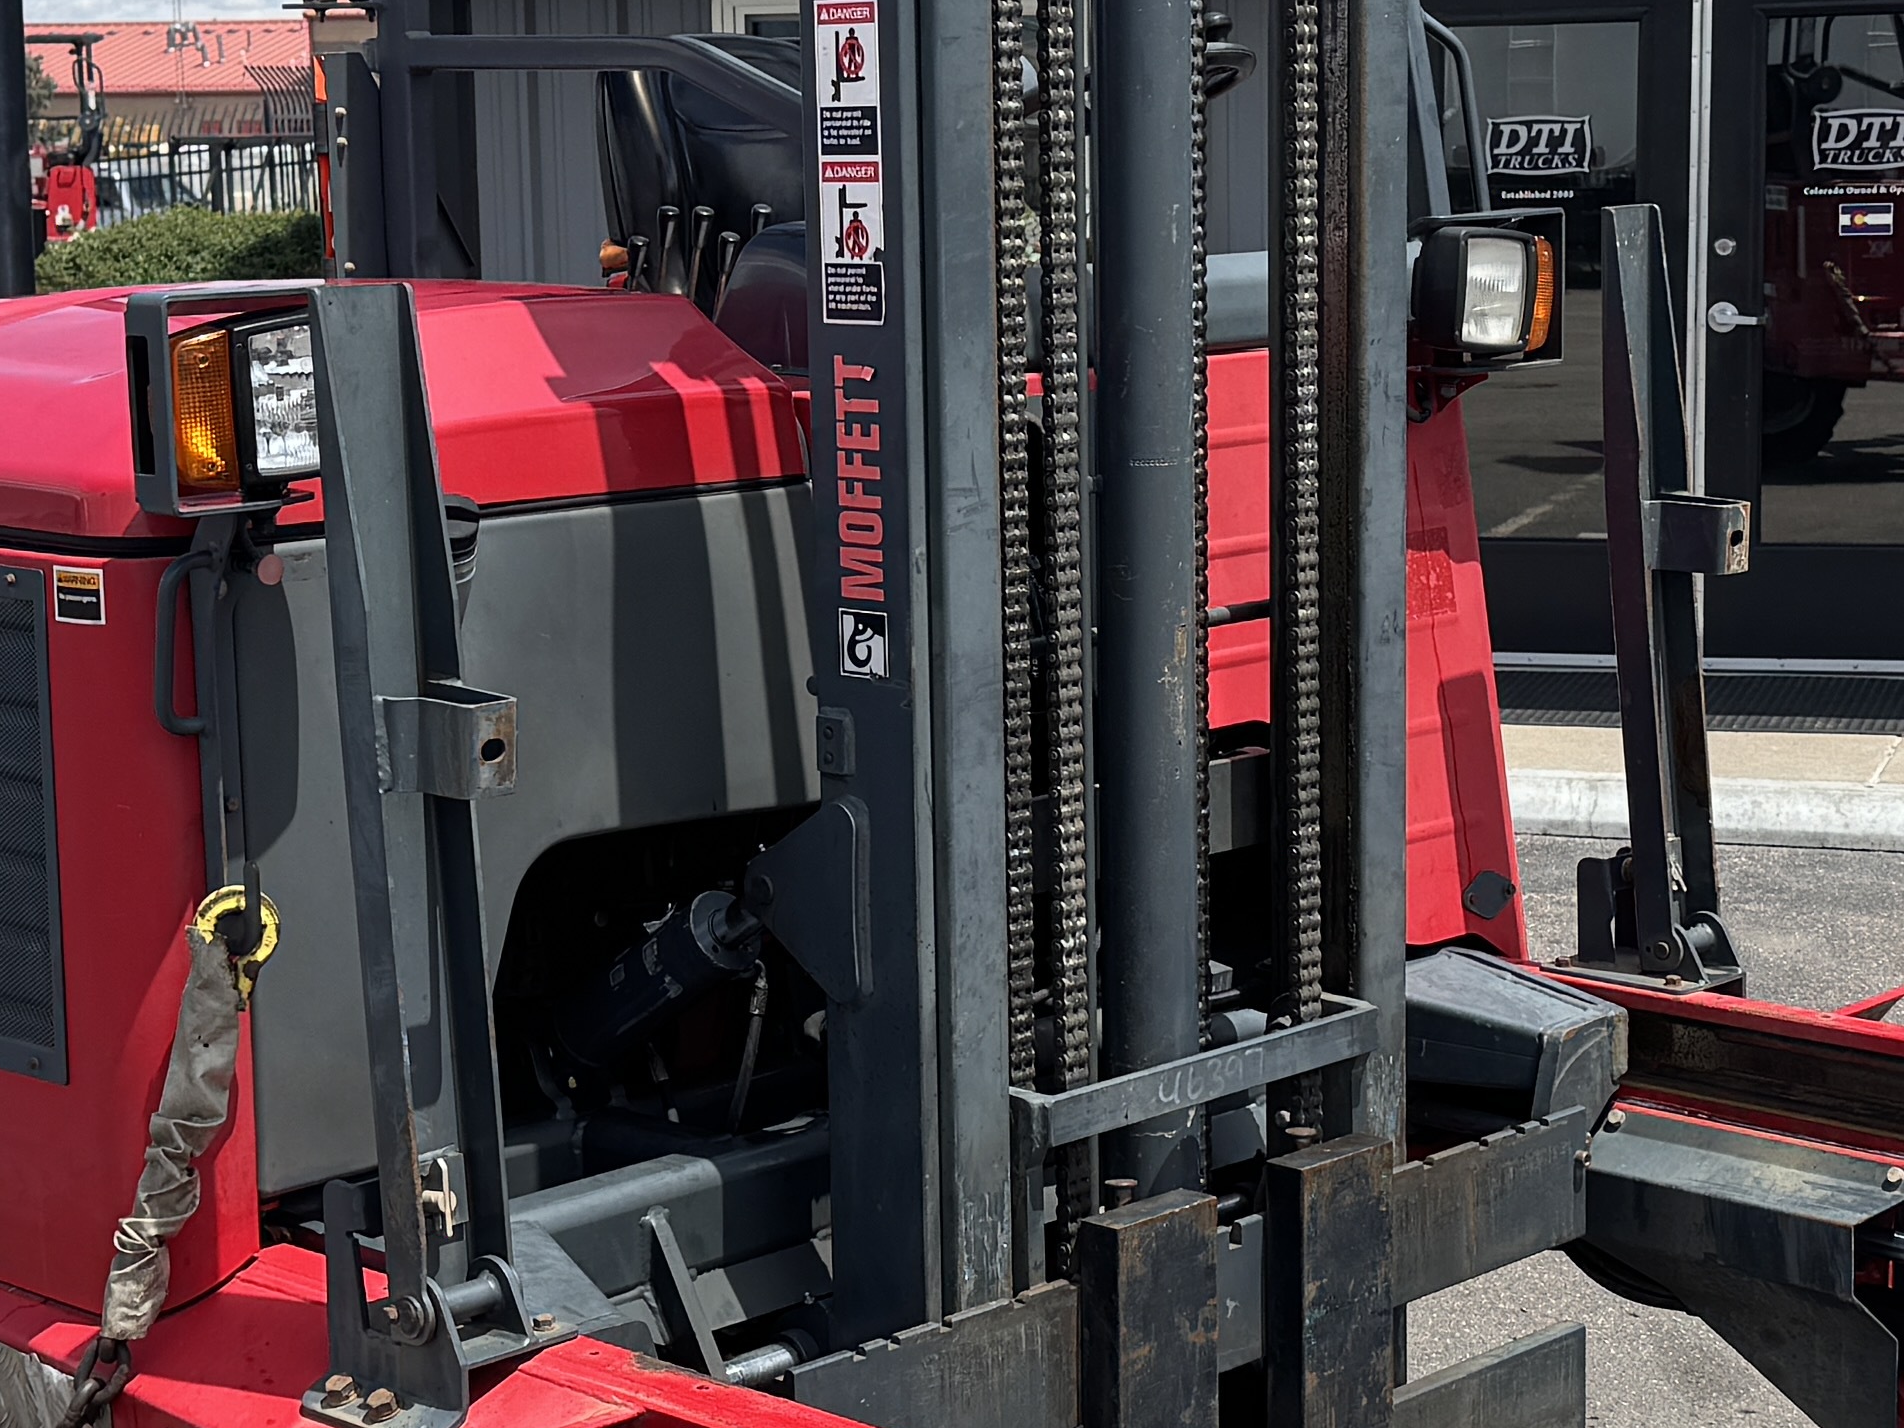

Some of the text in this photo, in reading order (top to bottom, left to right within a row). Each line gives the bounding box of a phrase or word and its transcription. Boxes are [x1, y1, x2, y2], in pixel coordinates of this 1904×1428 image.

[830, 7, 871, 21] DANGER
[1493, 122, 1582, 154] DTI
[1497, 154, 1579, 169] TRUCKS
[834, 166, 875, 178] DANGER
[1803, 186, 1845, 196] Colorado
[834, 354, 885, 602] MOFFETT
